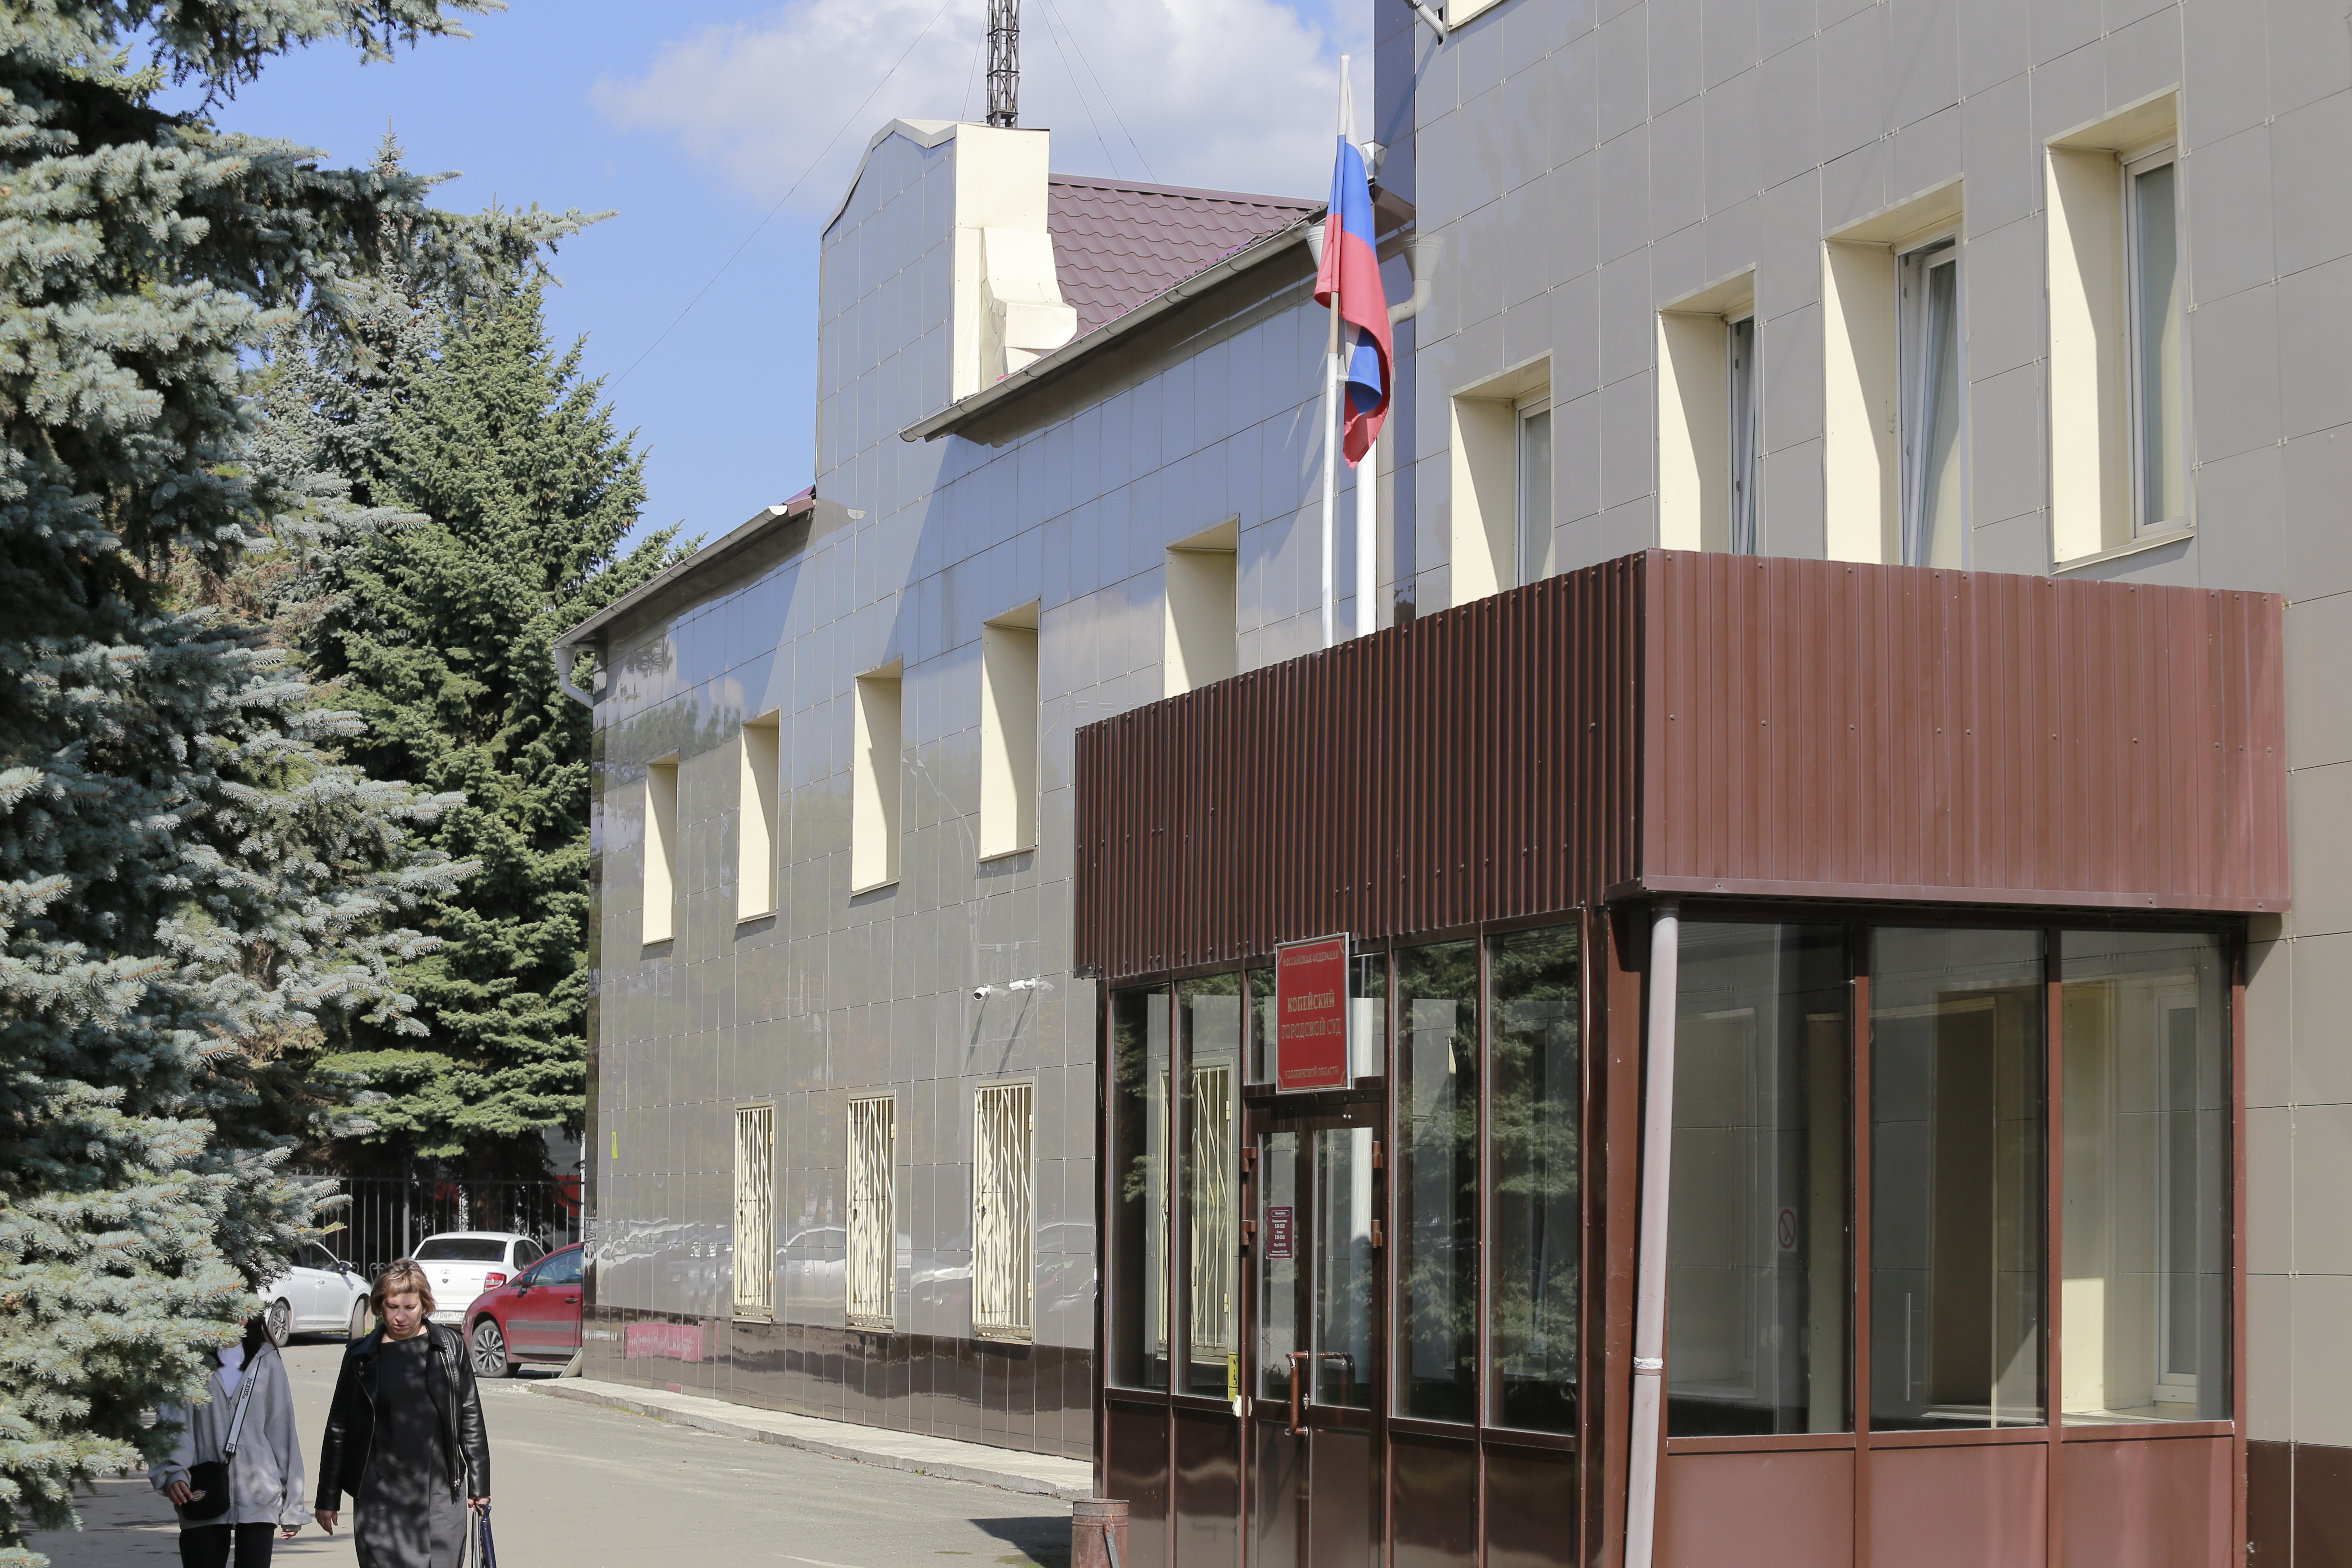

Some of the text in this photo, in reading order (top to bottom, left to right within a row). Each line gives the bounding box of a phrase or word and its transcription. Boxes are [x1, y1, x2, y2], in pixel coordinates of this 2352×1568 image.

[1283, 950, 1339, 967] РОССИЙСКАЯ ФЕДЕРАЦИЯ
[1287, 989, 1335, 1012] КОПЕЙСКИЙ
[1281, 1017, 1341, 1040] ГОРОДСКОЙ СУД
[1284, 1066, 1339, 1079] ЧЕЛЯБИНСКОЙ ОБЛАСТИ
[243, 1378, 252, 1396] DICKIES
